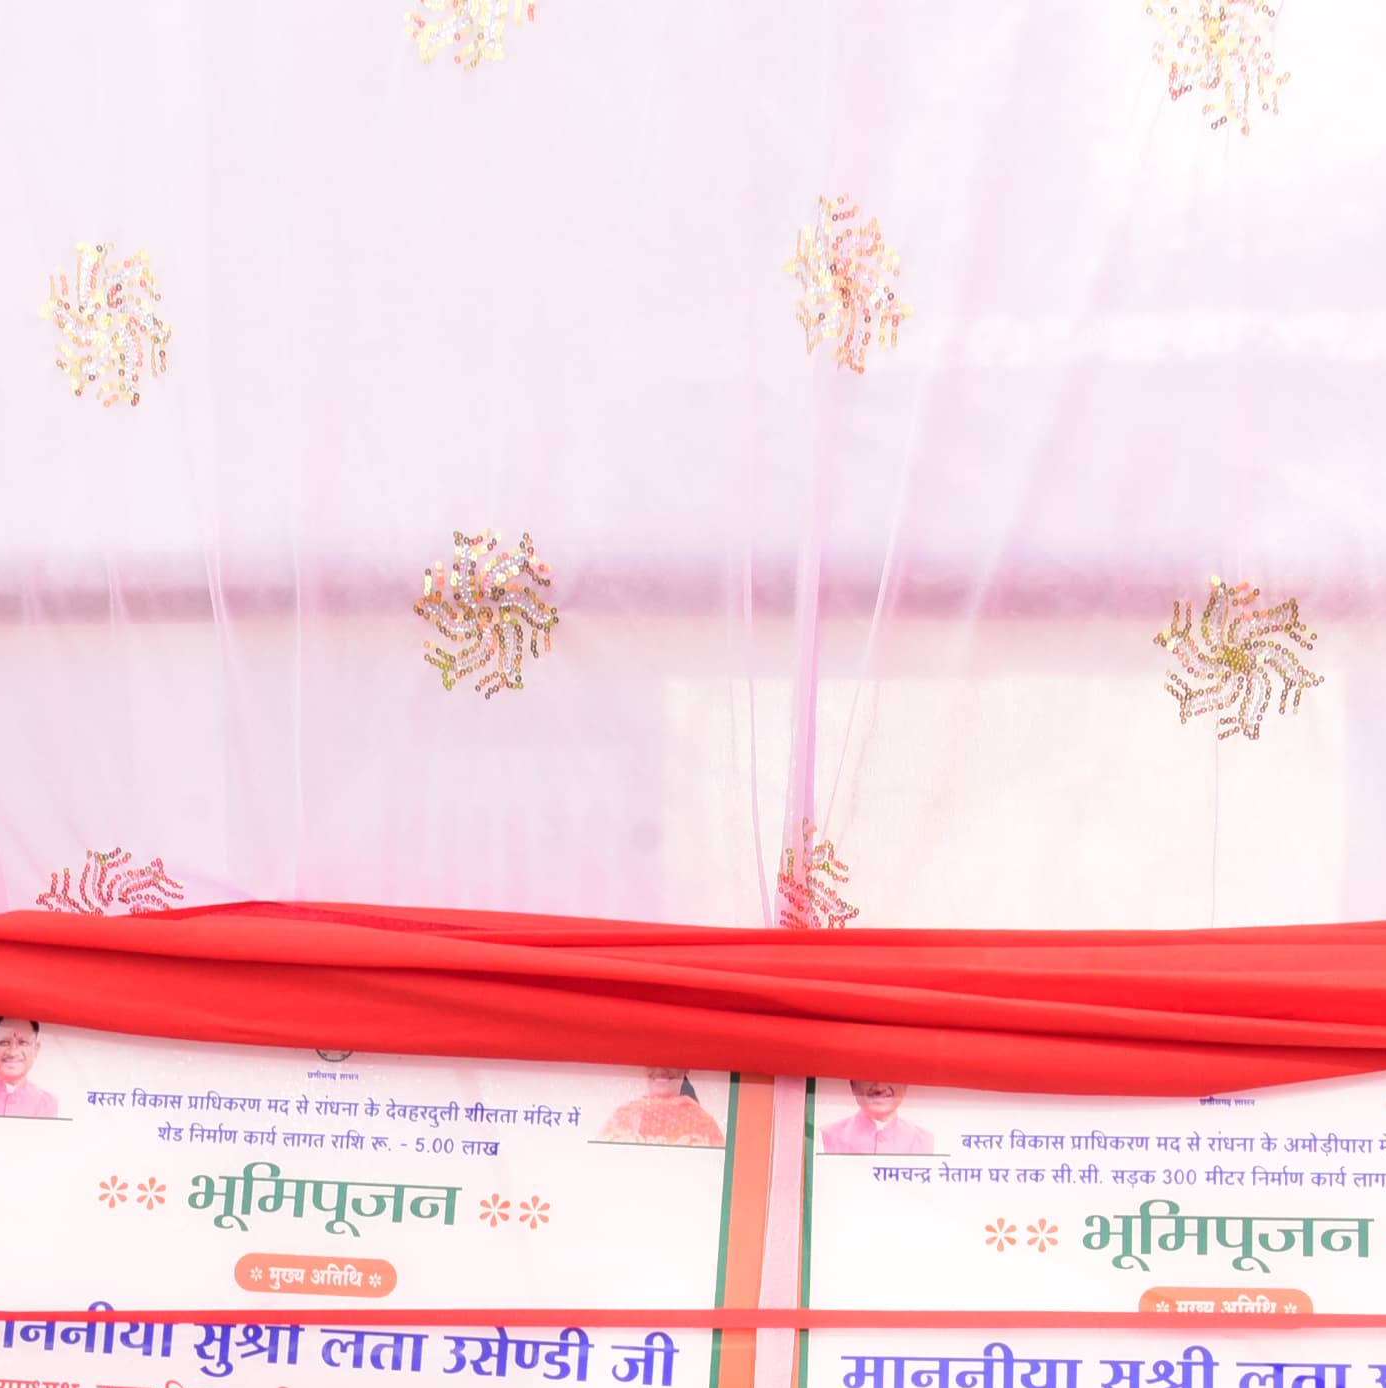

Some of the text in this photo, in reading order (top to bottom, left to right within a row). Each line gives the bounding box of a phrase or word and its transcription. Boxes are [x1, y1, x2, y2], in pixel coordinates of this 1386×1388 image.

[189, 1122, 238, 1144] निर्माण
[243, 1125, 277, 1146] कार्य
[331, 1129, 365, 1150] राशि
[188, 1161, 462, 1237] भूमिपूजन
[1082, 1199, 1374, 1273] भूमिपूजन
[268, 1263, 363, 1290] मुख्य अतिथि
